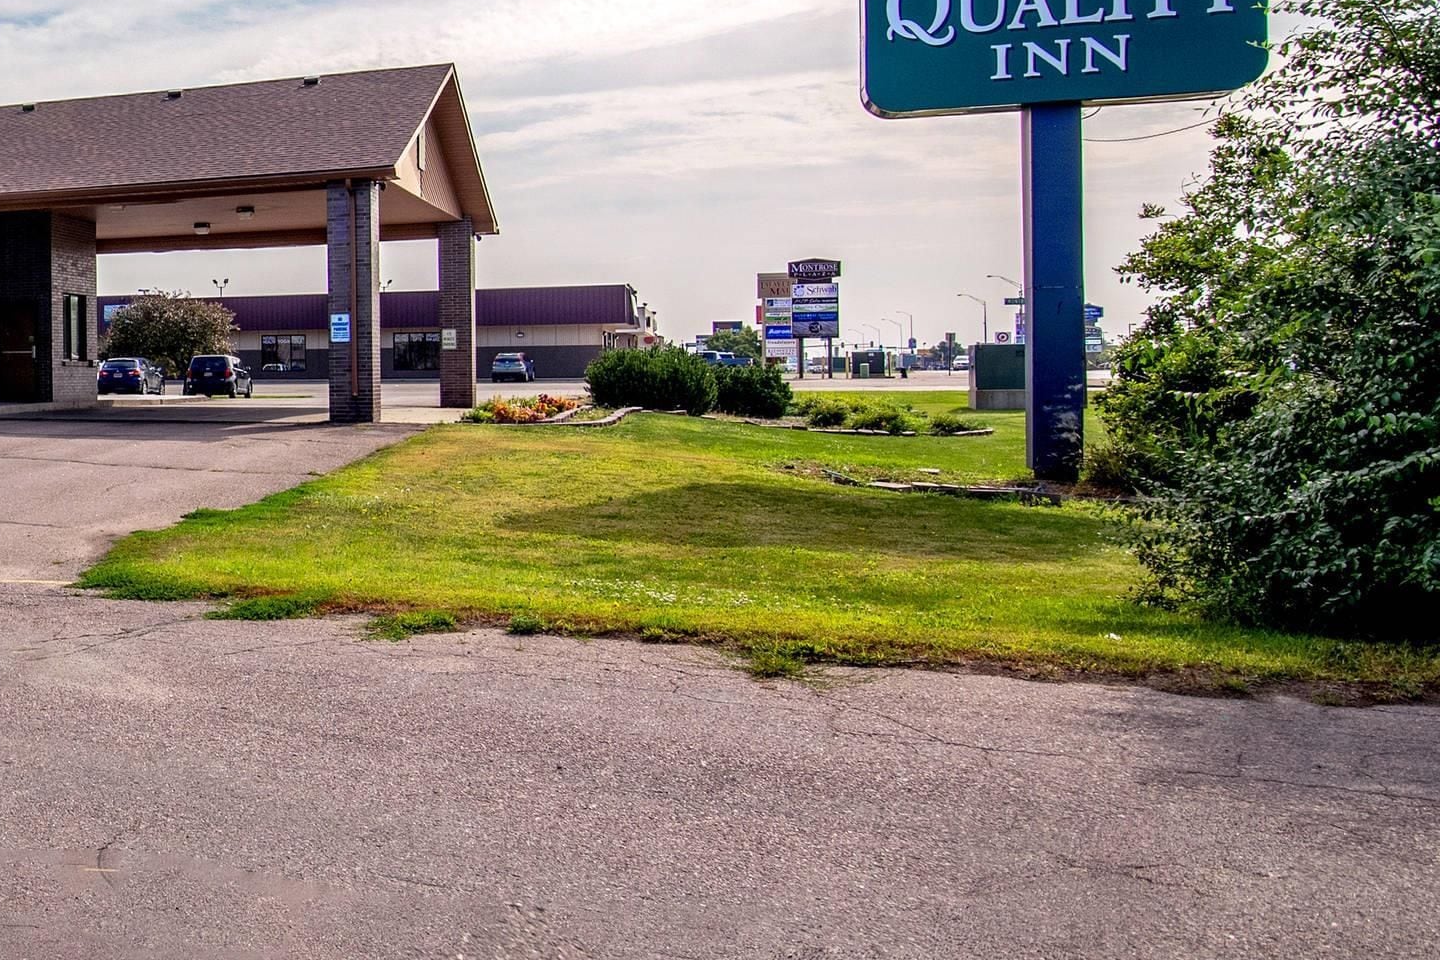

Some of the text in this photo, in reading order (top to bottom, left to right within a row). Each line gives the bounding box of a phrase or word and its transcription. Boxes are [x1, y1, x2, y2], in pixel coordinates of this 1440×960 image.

[990, 33, 1131, 81] INN
[791, 263, 838, 273] MONTROSE
[806, 285, 837, 294] Schwab
